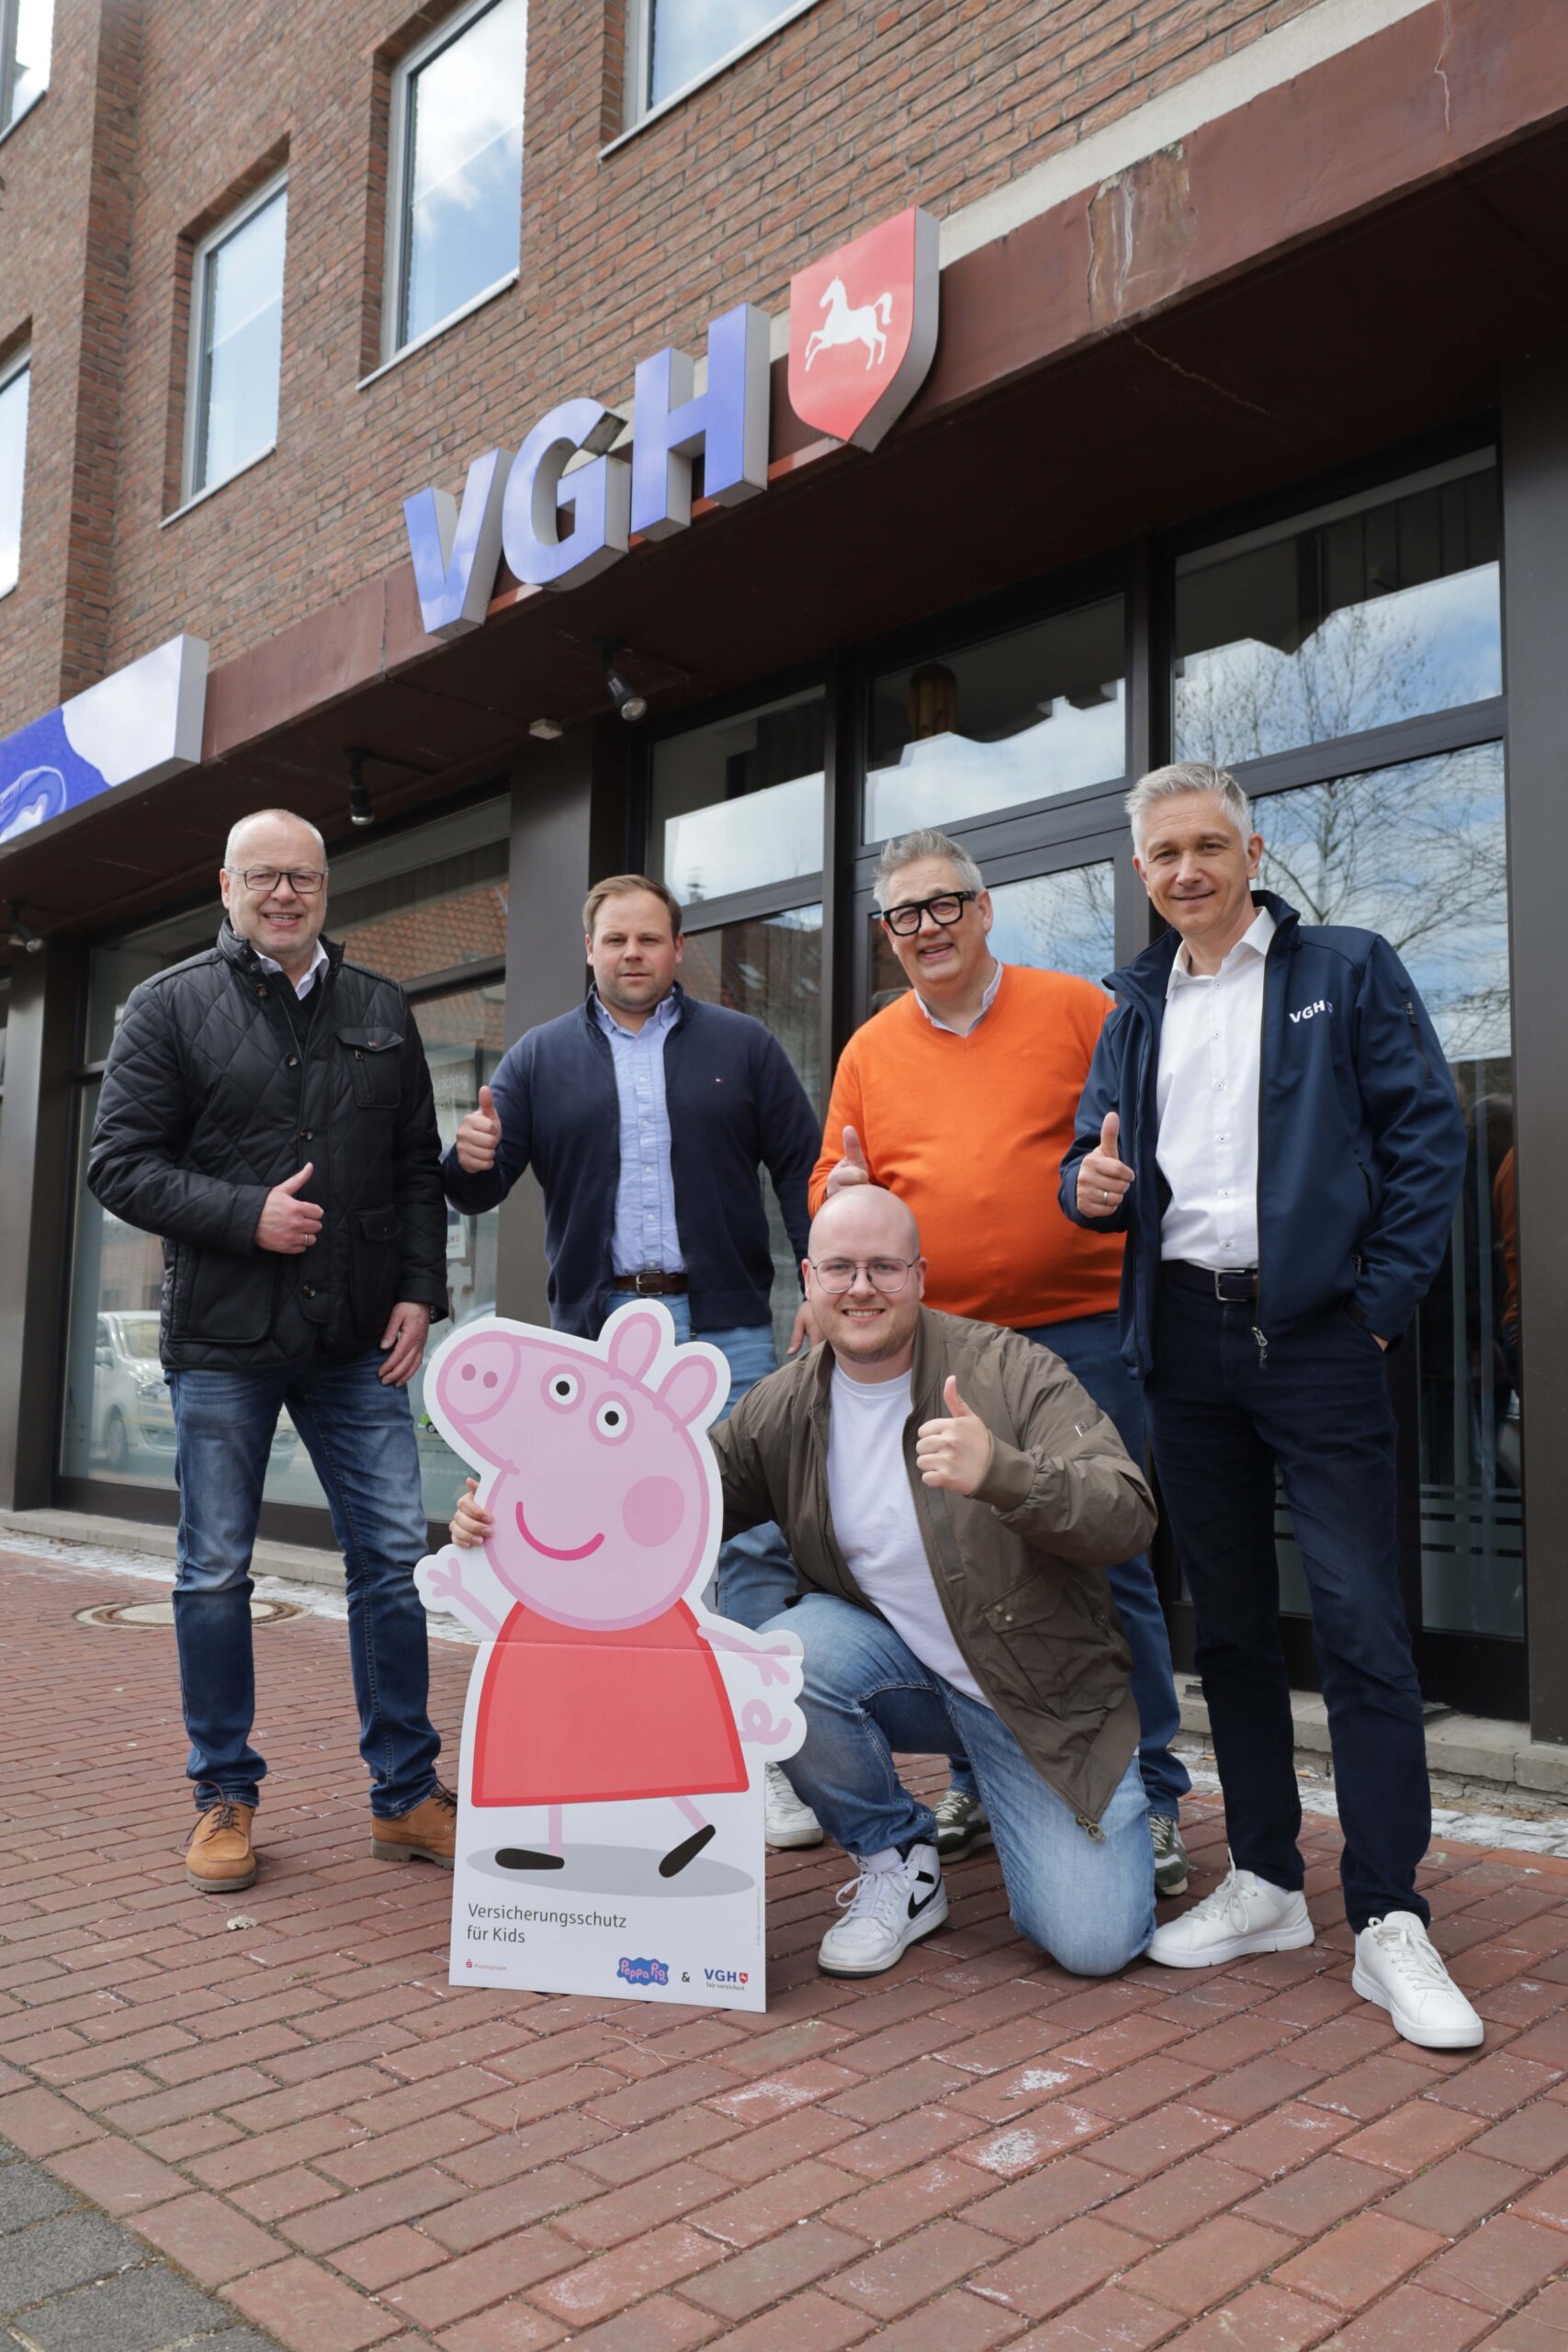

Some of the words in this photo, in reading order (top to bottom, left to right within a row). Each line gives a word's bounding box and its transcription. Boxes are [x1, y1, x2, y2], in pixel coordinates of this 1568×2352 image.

[403, 300, 770, 639] VGH
[1289, 1000, 1325, 1023] VGH
[468, 1903, 626, 1928] Versicherungsschutz
[467, 1925, 491, 1940] für
[493, 1928, 525, 1943] Kids
[620, 1959, 649, 1980] Peppa
[650, 1962, 667, 1982] Pig
[681, 1972, 690, 1982] &
[704, 1968, 737, 1982] VGH
[716, 1984, 745, 1992] versichert
